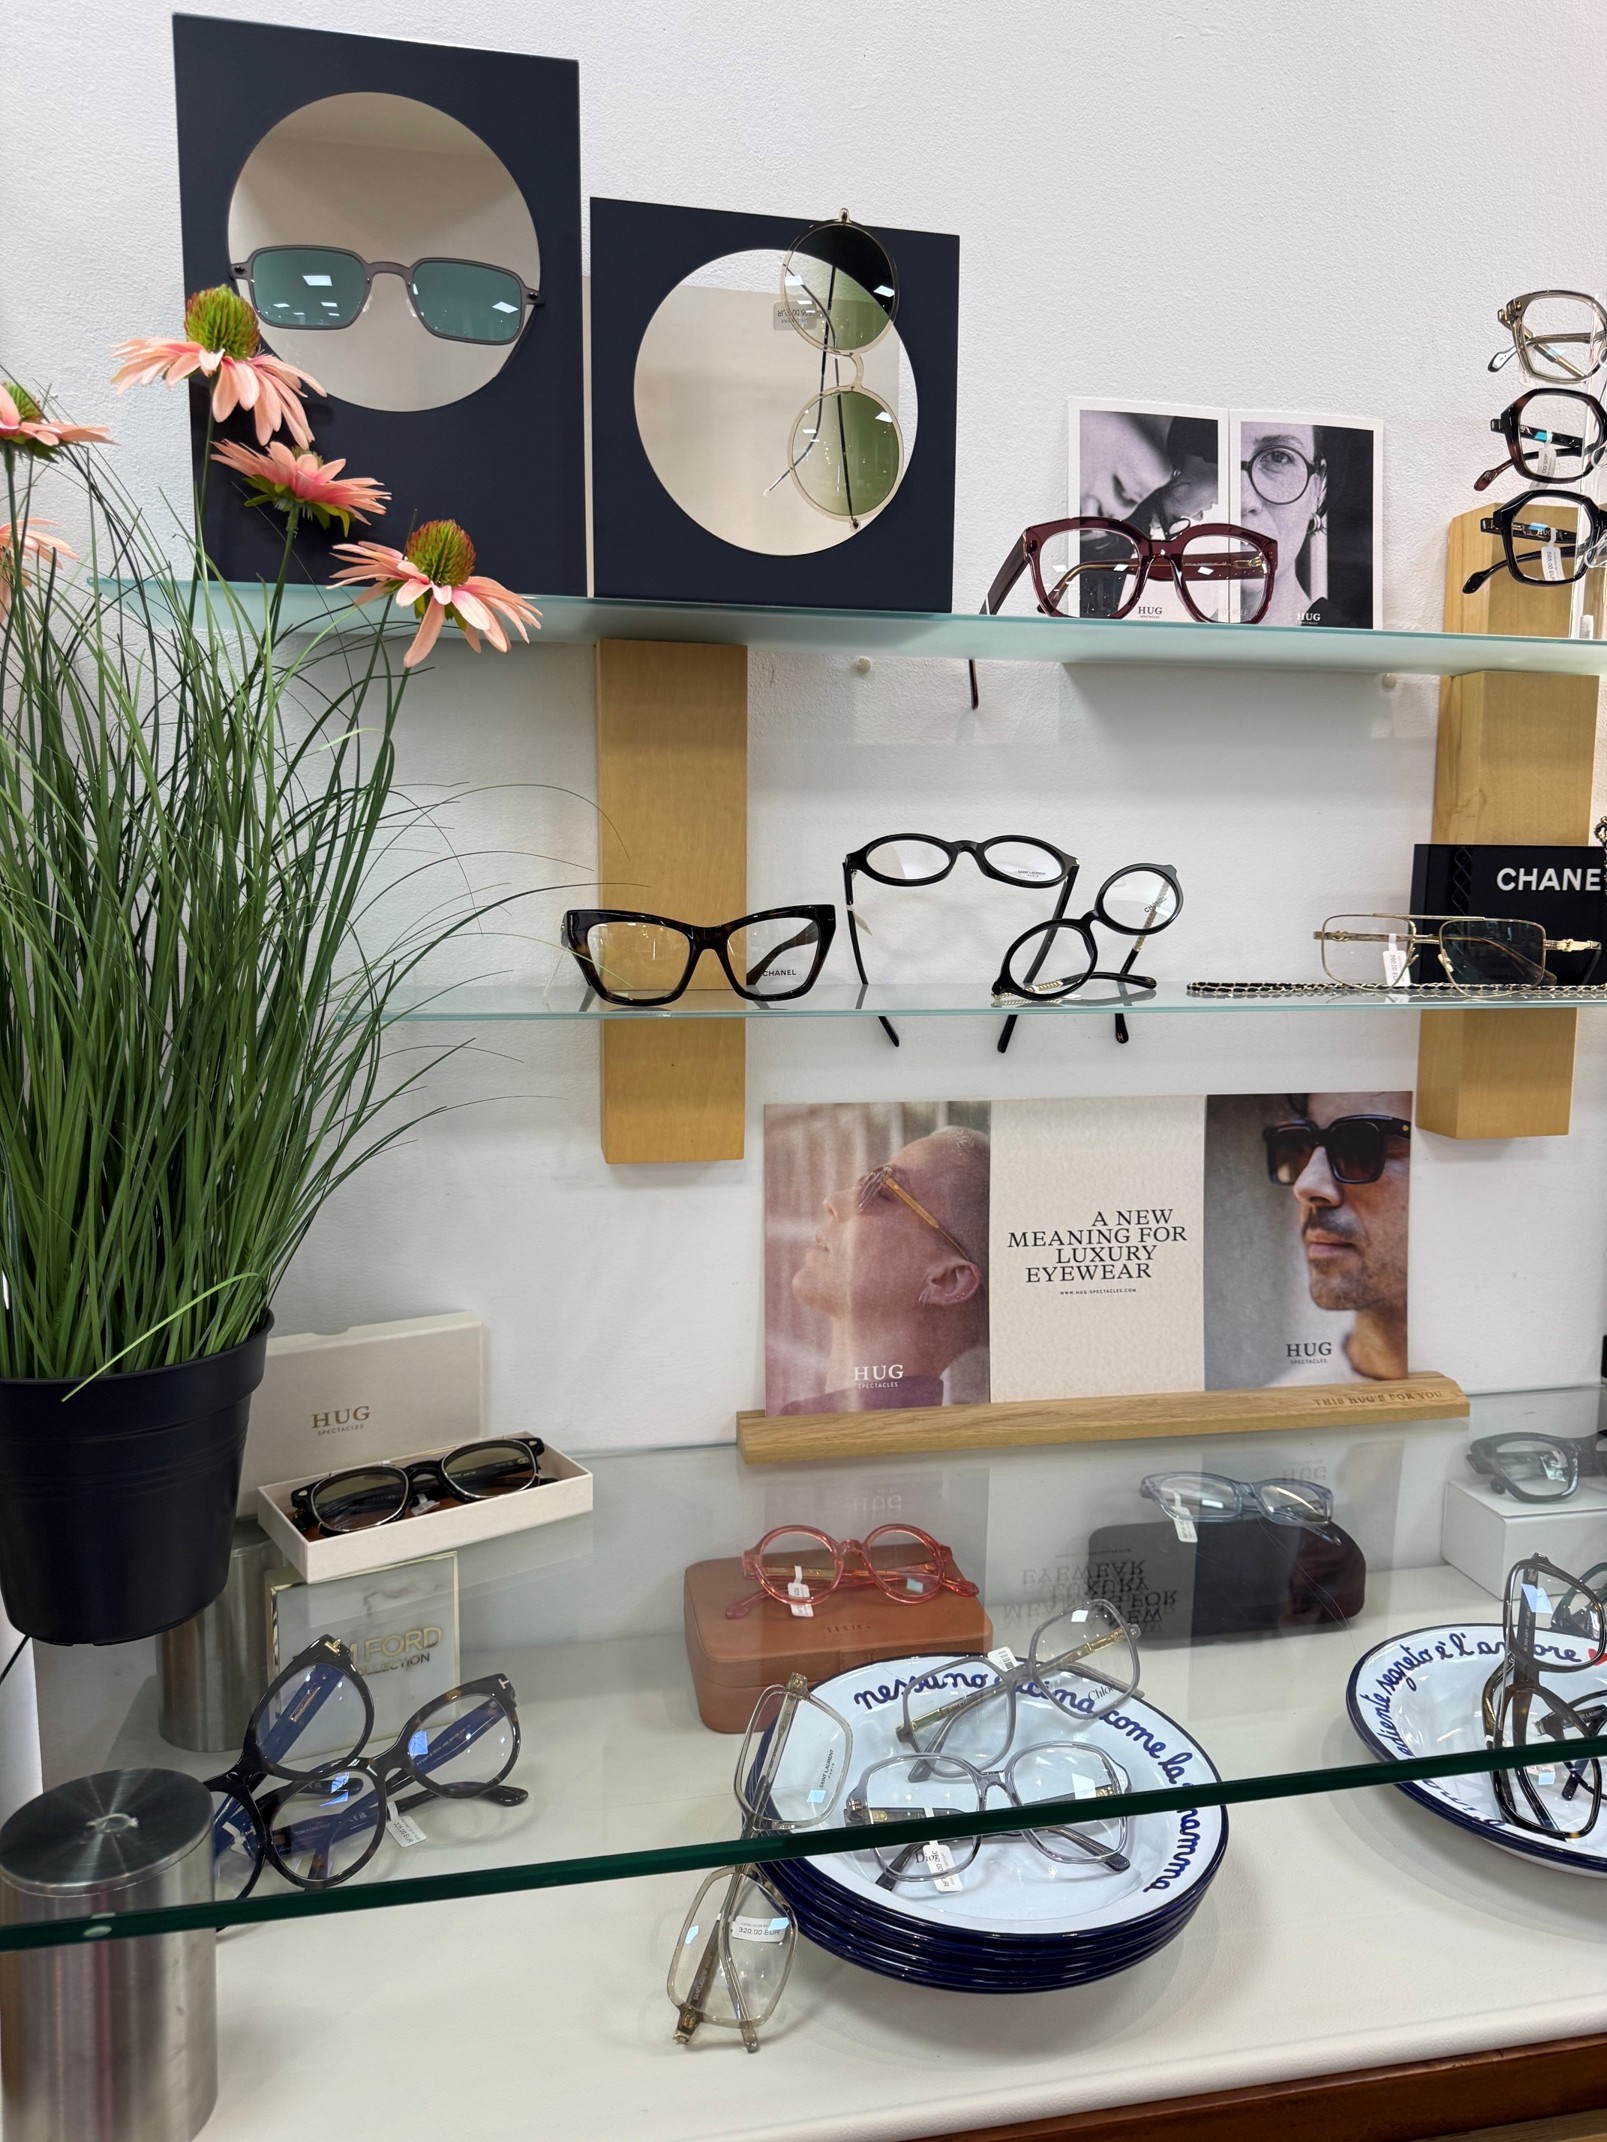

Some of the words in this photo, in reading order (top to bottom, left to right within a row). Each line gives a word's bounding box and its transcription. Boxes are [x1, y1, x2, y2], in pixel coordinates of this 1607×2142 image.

[1138, 606, 1163, 615] HUG
[1297, 612, 1321, 622] HUG
[1496, 867, 1602, 891] CHANE
[762, 969, 797, 977] CHANEL
[1091, 1211, 1108, 1227] A
[1116, 1208, 1174, 1226] NEW
[1007, 1227, 1131, 1248] MEANING
[1138, 1225, 1188, 1243] FOR
[1055, 1245, 1158, 1264] LUXURY
[1025, 1262, 1152, 1283] EYEWEAR
[1286, 1342, 1332, 1358] HUG
[854, 1364, 904, 1381] HUG
[859, 1381, 898, 1389] SPECTACLES
[1314, 1397, 1345, 1407] THIS
[1349, 1394, 1386, 1405] HUG'S
[1389, 1392, 1415, 1402] FOR
[1415, 1390, 1443, 1400] YOU
[311, 1405, 370, 1429] HUG
[317, 1424, 364, 1436] SPECTACLES
[364, 1627, 444, 1662] FORD
[1375, 1644, 1434, 1695] segreto
[853, 1672, 989, 1710] nessuno
[994, 1681, 1096, 1714] ccina
[1100, 1709, 1167, 1759] come
[1157, 1752, 1193, 1785] la
